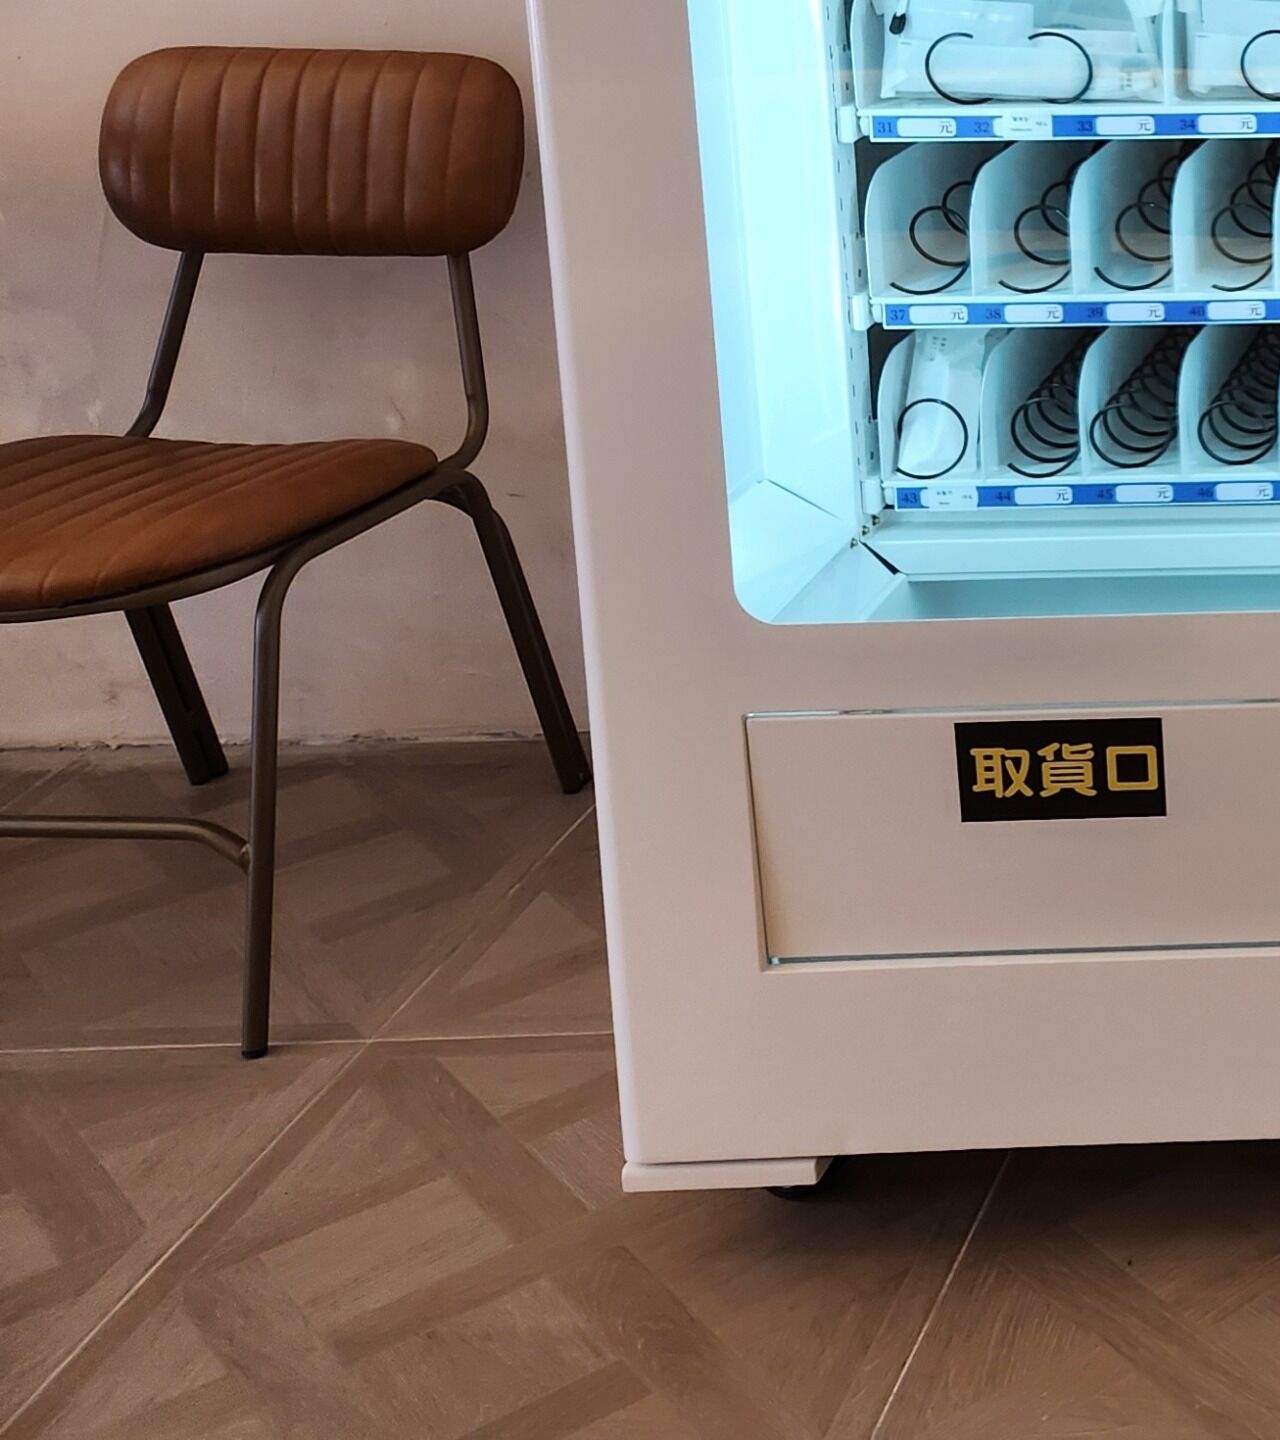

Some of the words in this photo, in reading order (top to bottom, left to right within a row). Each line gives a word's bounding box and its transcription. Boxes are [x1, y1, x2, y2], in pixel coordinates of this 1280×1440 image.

[938, 121, 954, 134] 元
[1137, 119, 1151, 132] 元
[1240, 117, 1253, 130] 元
[951, 306, 965, 321] 元
[1046, 305, 1060, 319] 元
[1149, 305, 1162, 318] 元
[1249, 305, 1262, 317] 元
[1055, 489, 1070, 502] 元
[1156, 487, 1171, 499] 元
[1255, 485, 1270, 498] 元
[969, 742, 1159, 799] 取貨口
